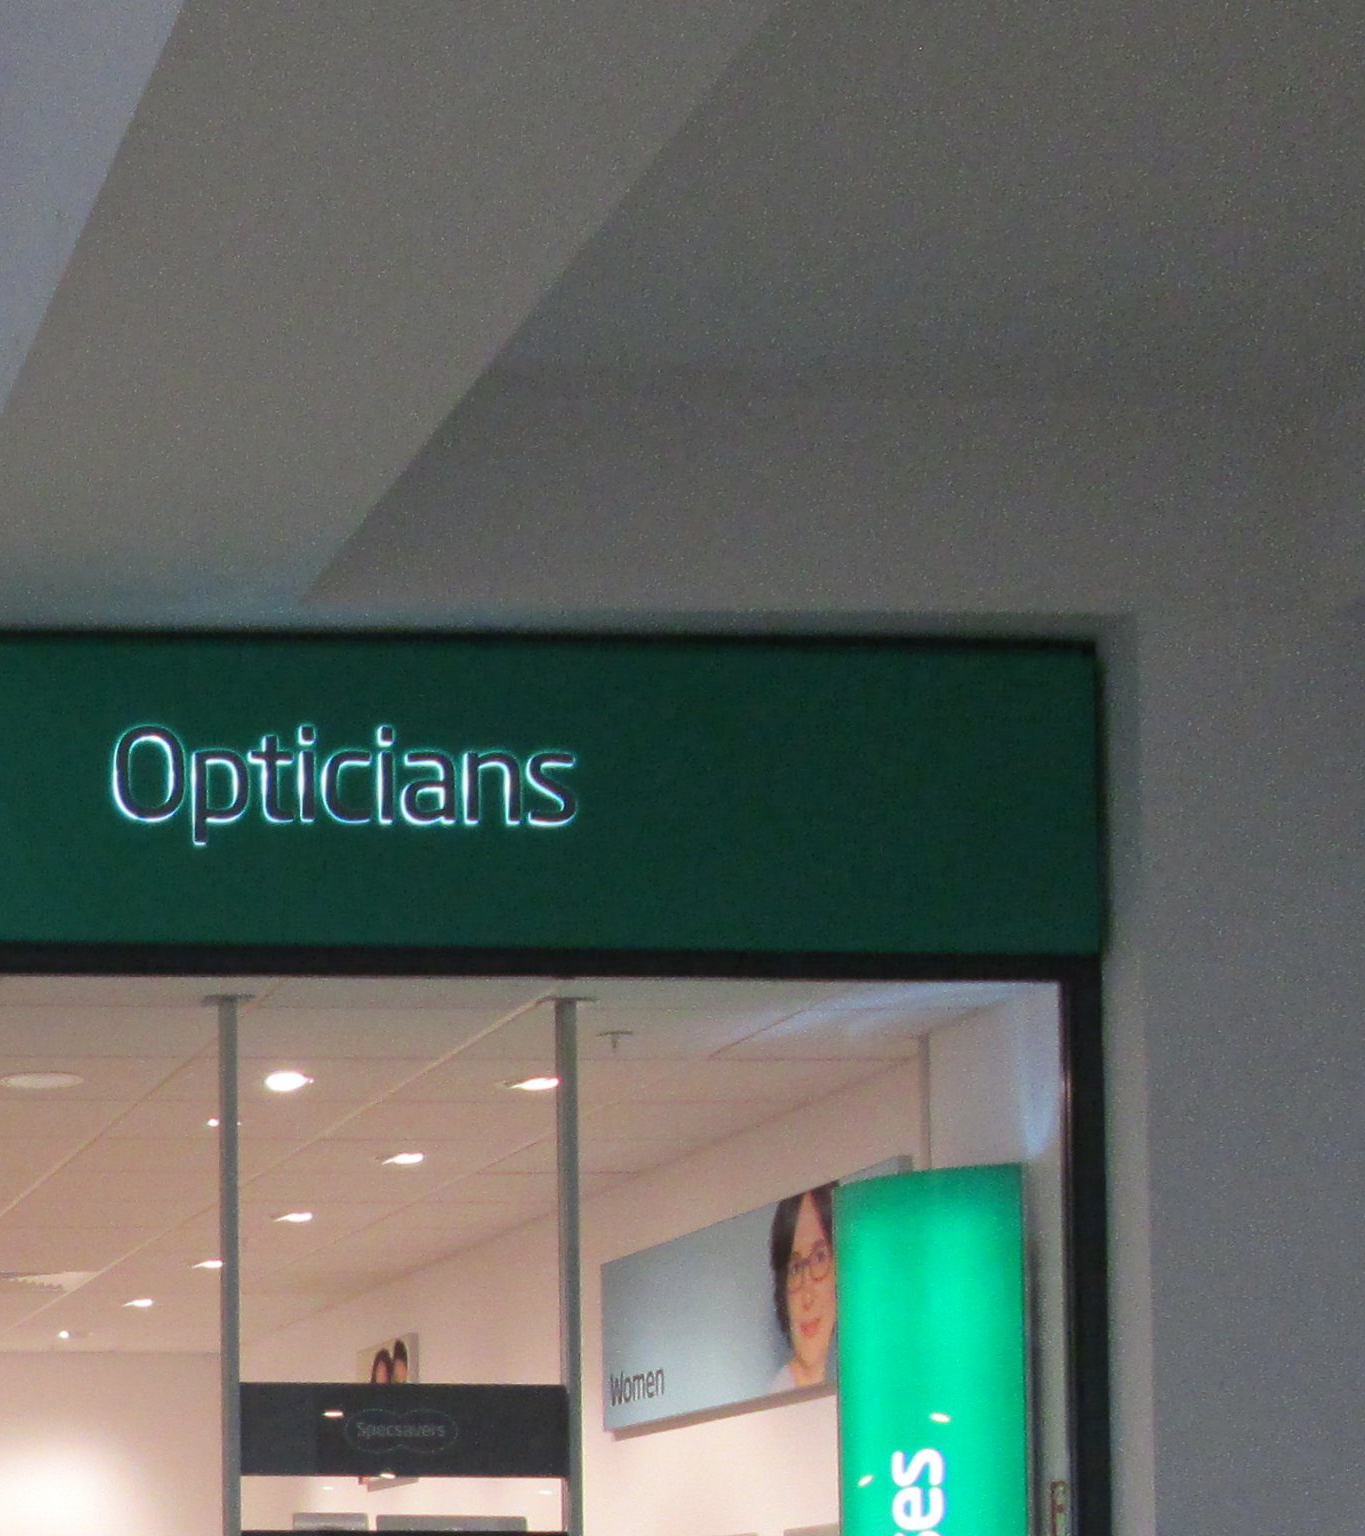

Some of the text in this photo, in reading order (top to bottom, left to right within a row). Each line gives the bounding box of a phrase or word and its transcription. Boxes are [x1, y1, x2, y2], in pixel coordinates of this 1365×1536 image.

[112, 725, 577, 846] Opticians
[610, 1369, 665, 1407] Women
[356, 1421, 445, 1440] Specsavers
